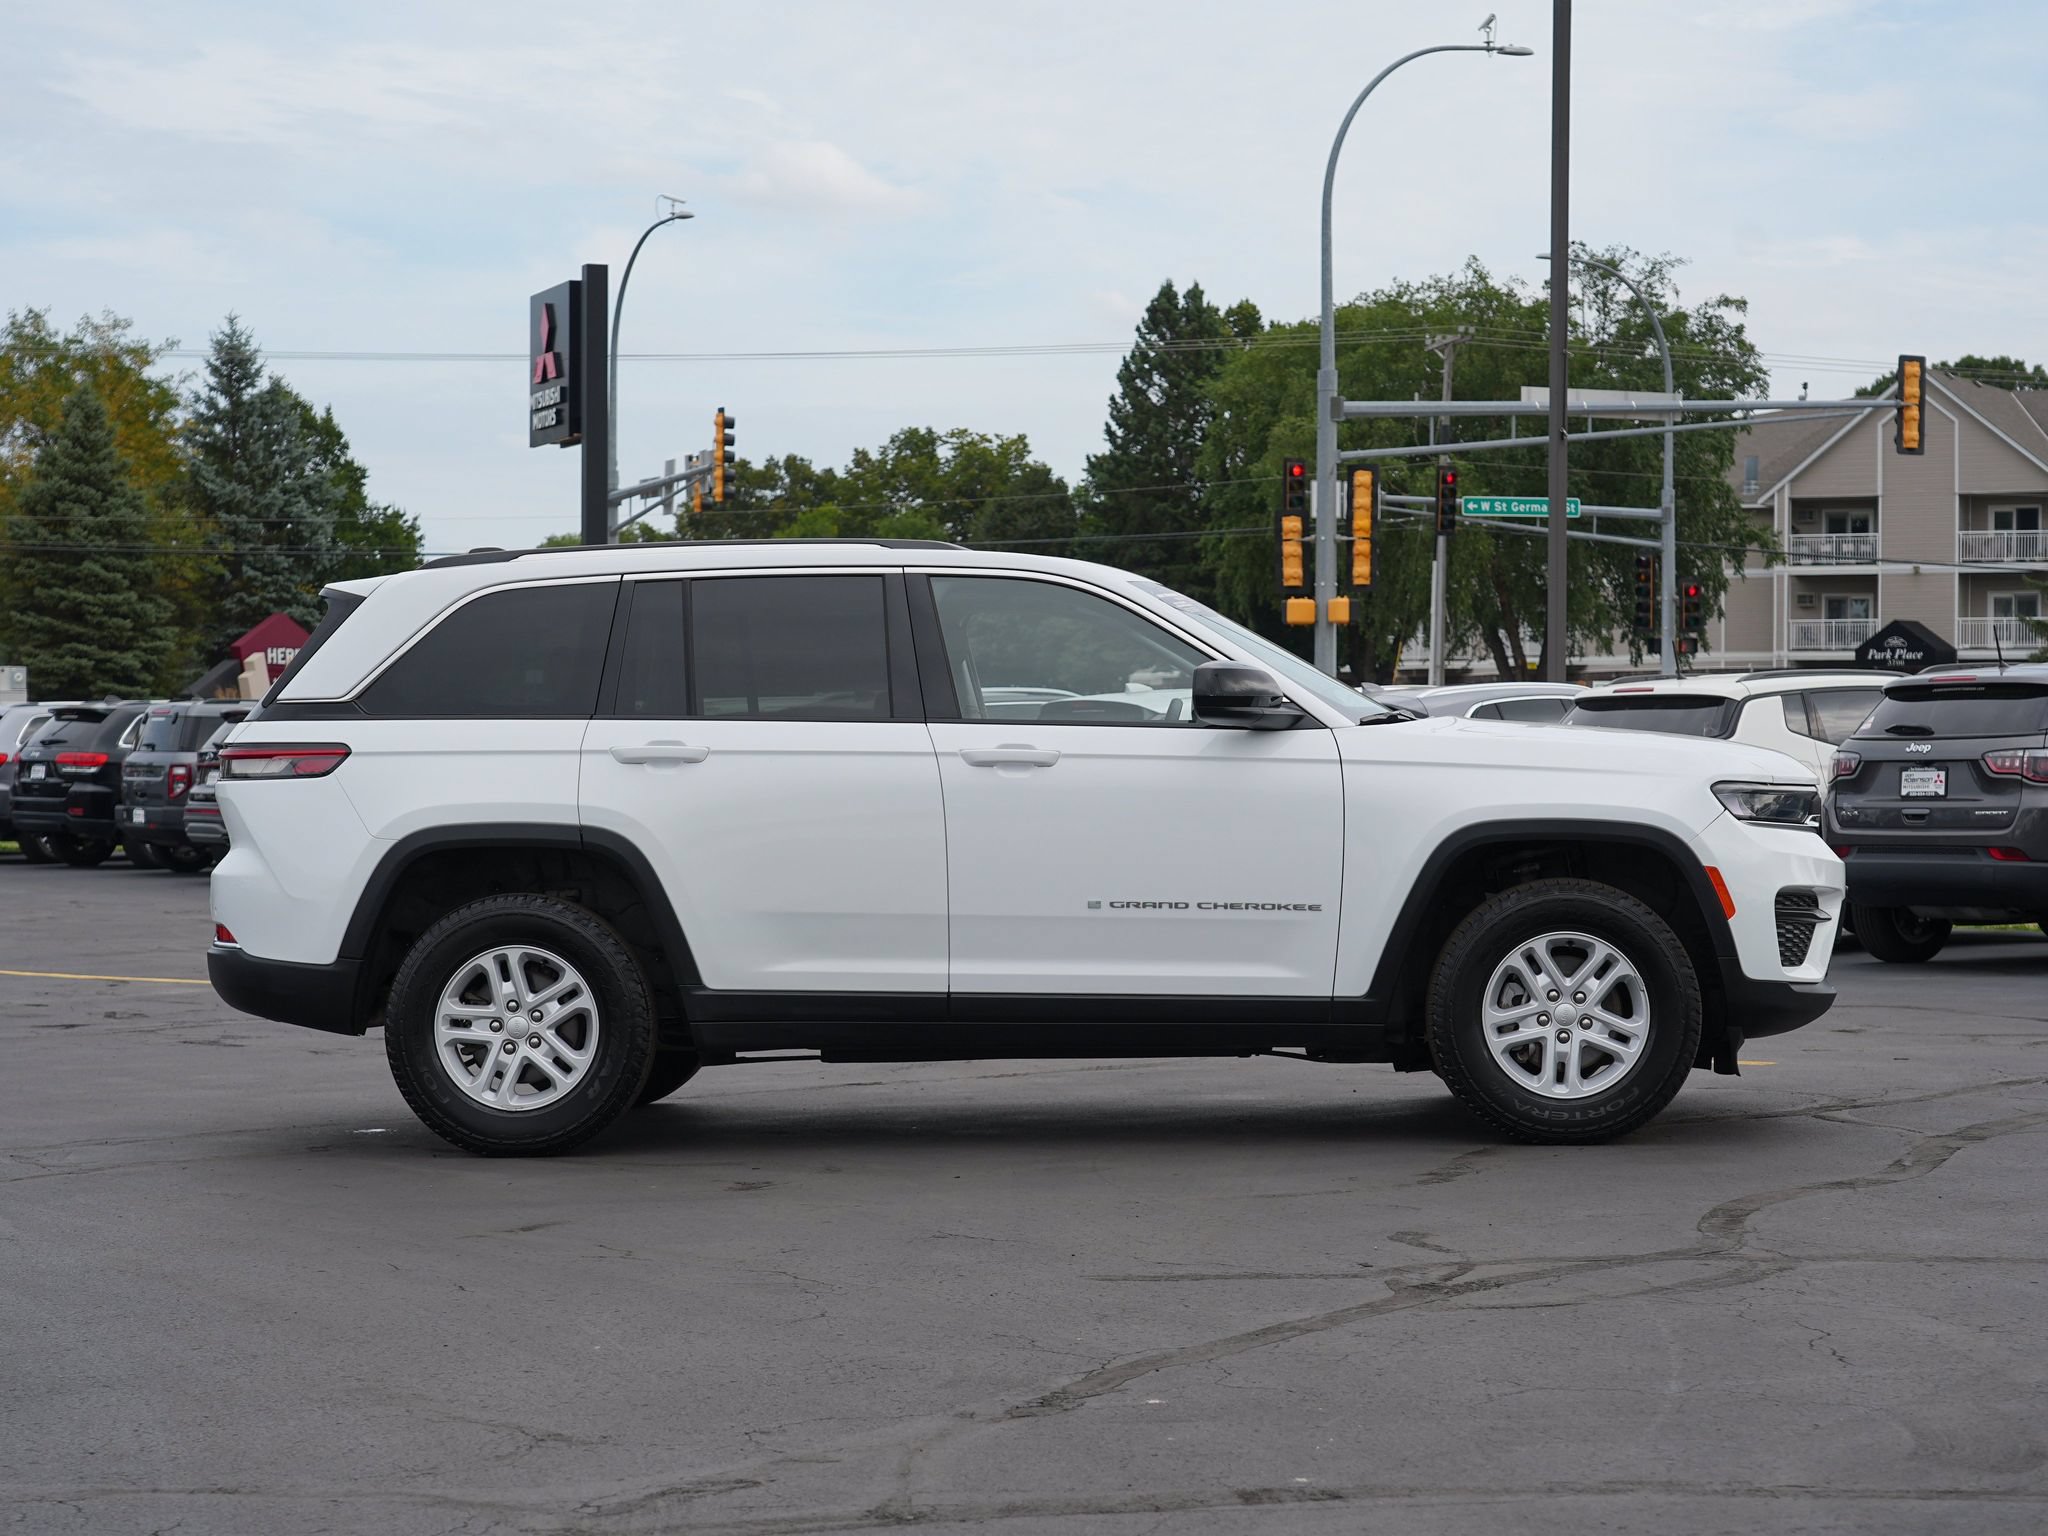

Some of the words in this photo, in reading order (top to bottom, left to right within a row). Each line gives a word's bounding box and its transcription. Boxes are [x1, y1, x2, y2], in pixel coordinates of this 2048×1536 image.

[532, 407, 557, 431] MOTORS
[1480, 501, 1491, 511] W
[1494, 501, 1508, 512] St
[1511, 501, 1549, 513] Germa
[1867, 648, 1893, 660] Park
[1894, 648, 1924, 660] Place
[1905, 742, 1932, 754] Jeep
[1109, 901, 1190, 910] GRAND
[1196, 902, 1323, 912] CHEROKEE
[1513, 1086, 1641, 1121] FORTERA
